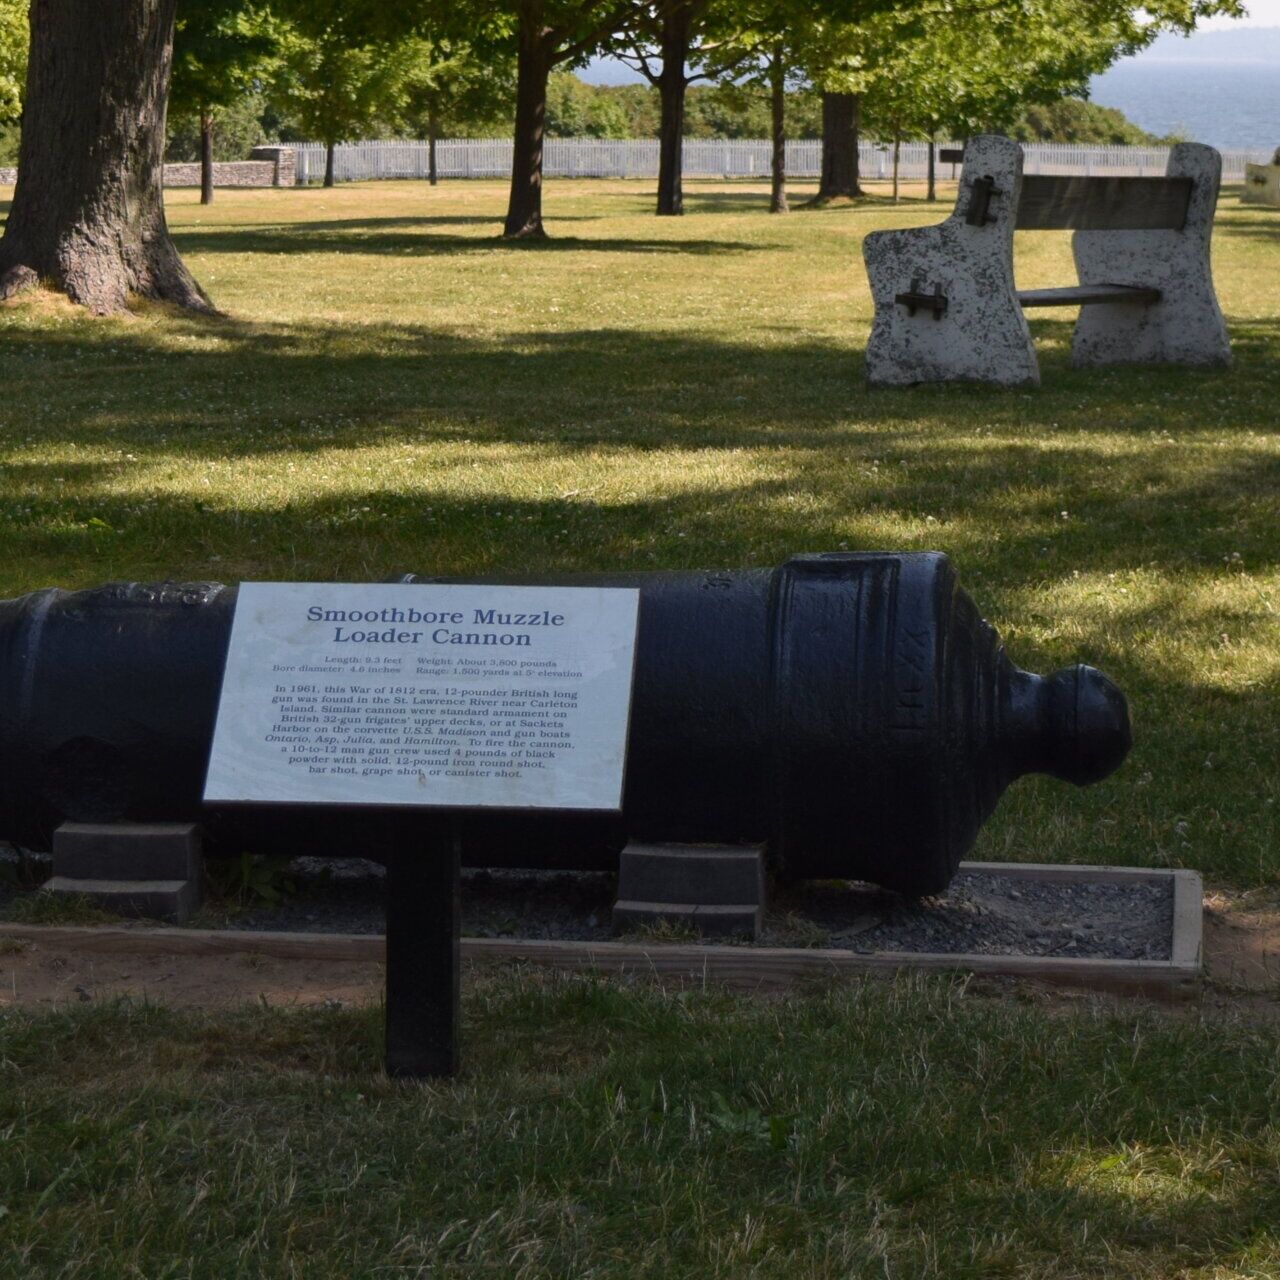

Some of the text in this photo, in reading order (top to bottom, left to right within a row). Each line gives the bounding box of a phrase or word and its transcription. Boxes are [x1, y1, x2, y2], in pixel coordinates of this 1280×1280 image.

[307, 606, 565, 626] Smoothbore Muzzle
[333, 626, 531, 646] Loader Cannon
[383, 656, 402, 665] feet
[456, 658, 487, 667] About
[519, 659, 557, 669] pounds
[272, 663, 296, 672] Bore
[368, 665, 401, 674] inches
[482, 668, 510, 677] yards
[512, 669, 523, 677] at
[537, 669, 583, 678] elevation
[275, 684, 578, 701] In 1961, this War of 1812 era, 12-pounder British long
[271, 696, 293, 705] gun
[321, 695, 354, 704] found
[356, 695, 368, 704] in
[372, 696, 391, 705] the
[393, 696, 409, 705] St.
[412, 697, 466, 706] Lawrence
[469, 698, 499, 707] River
[501, 700, 527, 708] near
[529, 699, 578, 709] Carleton
[280, 704, 317, 713] Island.
[320, 705, 362, 714] Similar
[440, 707, 489, 717] standard
[492, 709, 550, 718] armament
[280, 714, 319, 723] British
[323, 715, 362, 726] 32-gun
[414, 719, 447, 728] upper
[449, 717, 486, 728] decks,
[505, 719, 516, 727] at
[519, 719, 564, 728] Sackets
[272, 724, 311, 733] Harbor
[332, 725, 351, 734] the
[353, 726, 399, 735] corvette
[402, 726, 434, 736] U.S.S.
[437, 727, 488, 737] Madison
[489, 728, 511, 737] and
[513, 731, 536, 740] gun
[539, 729, 571, 738] boats
[264, 734, 575, 750] Ontario, Asp, Julia, and Hamilton. To fire the cannon,
[291, 744, 337, 754] 10-to-12
[367, 748, 391, 757] gun
[393, 748, 421, 756] crew
[424, 747, 451, 756] used
[454, 747, 461, 756] 4
[464, 748, 507, 759] pounds
[510, 749, 523, 758] of
[525, 749, 556, 758] black
[288, 754, 330, 766] powder
[333, 755, 357, 764] with
[396, 757, 449, 768] 12-pound
[452, 758, 476, 767] iron
[479, 758, 514, 768] round
[308, 765, 328, 774] bar
[361, 768, 394, 777] grape
[444, 768, 492, 777] canister
[494, 769, 522, 778] shot.
